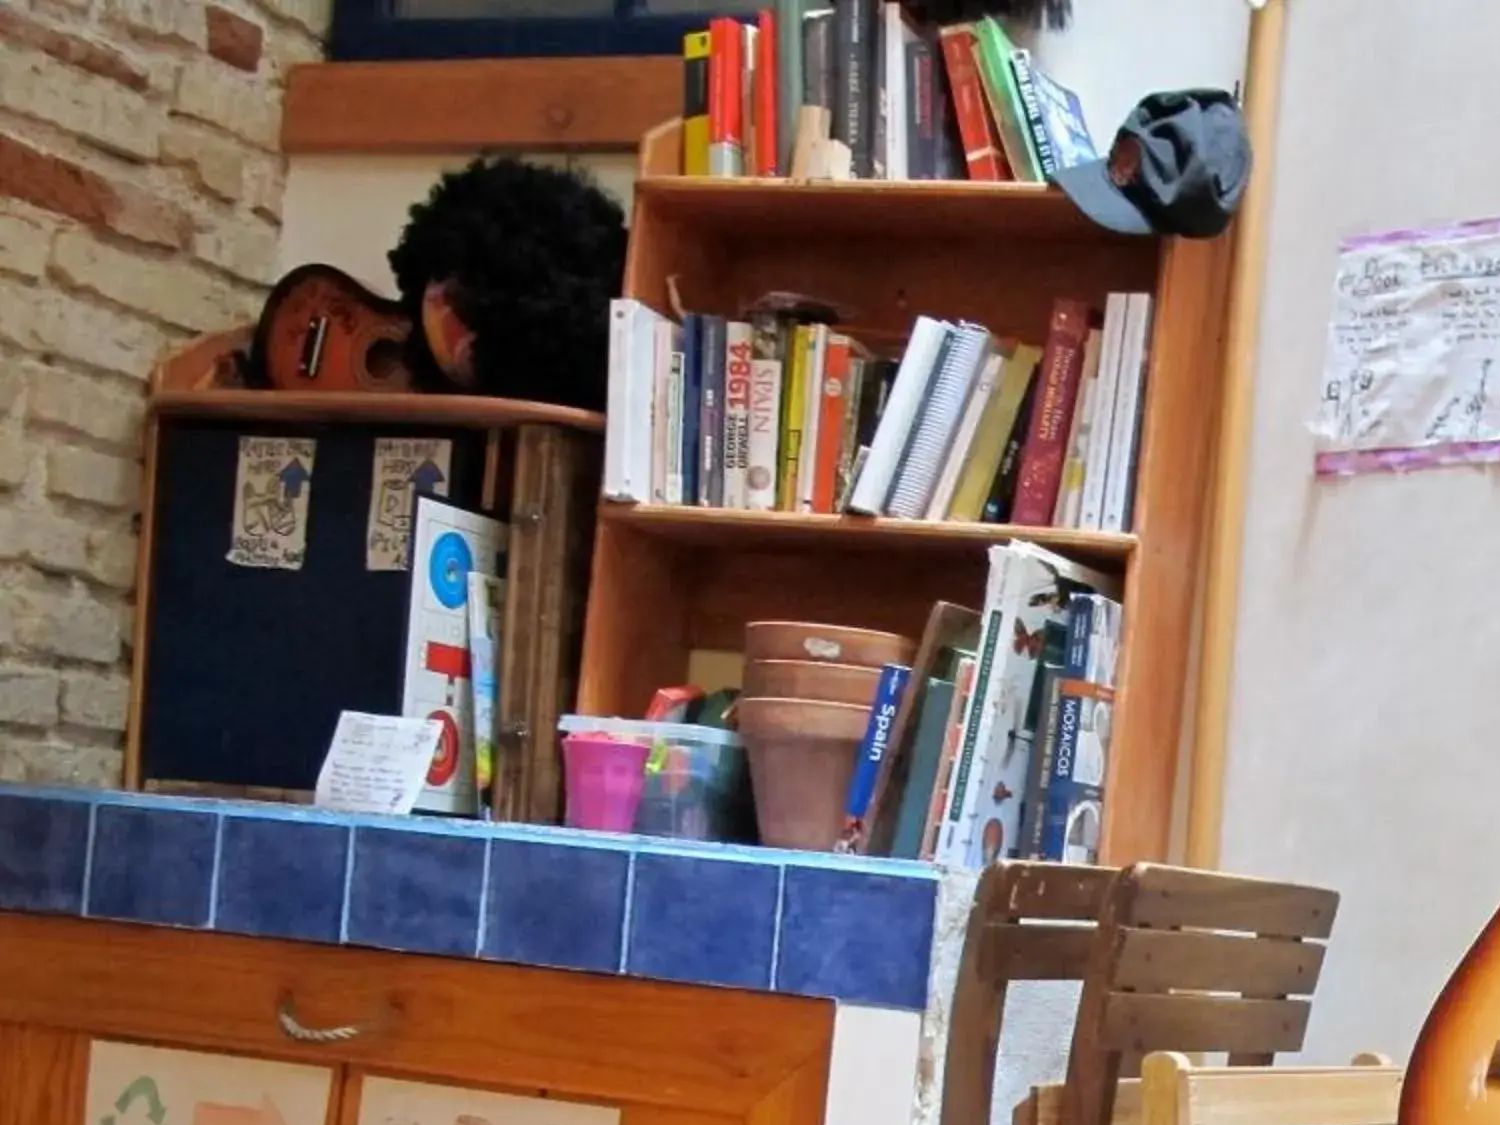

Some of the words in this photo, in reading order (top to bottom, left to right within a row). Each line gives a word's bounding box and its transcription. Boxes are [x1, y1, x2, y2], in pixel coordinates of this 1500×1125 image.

[728, 340, 751, 411] 1984
[753, 367, 774, 433] SPAIN
[725, 412, 737, 469] GEORGE
[738, 412, 750, 469] ORWELL
[869, 703, 895, 761] Spain
[1056, 699, 1076, 776] MOSAICOS
